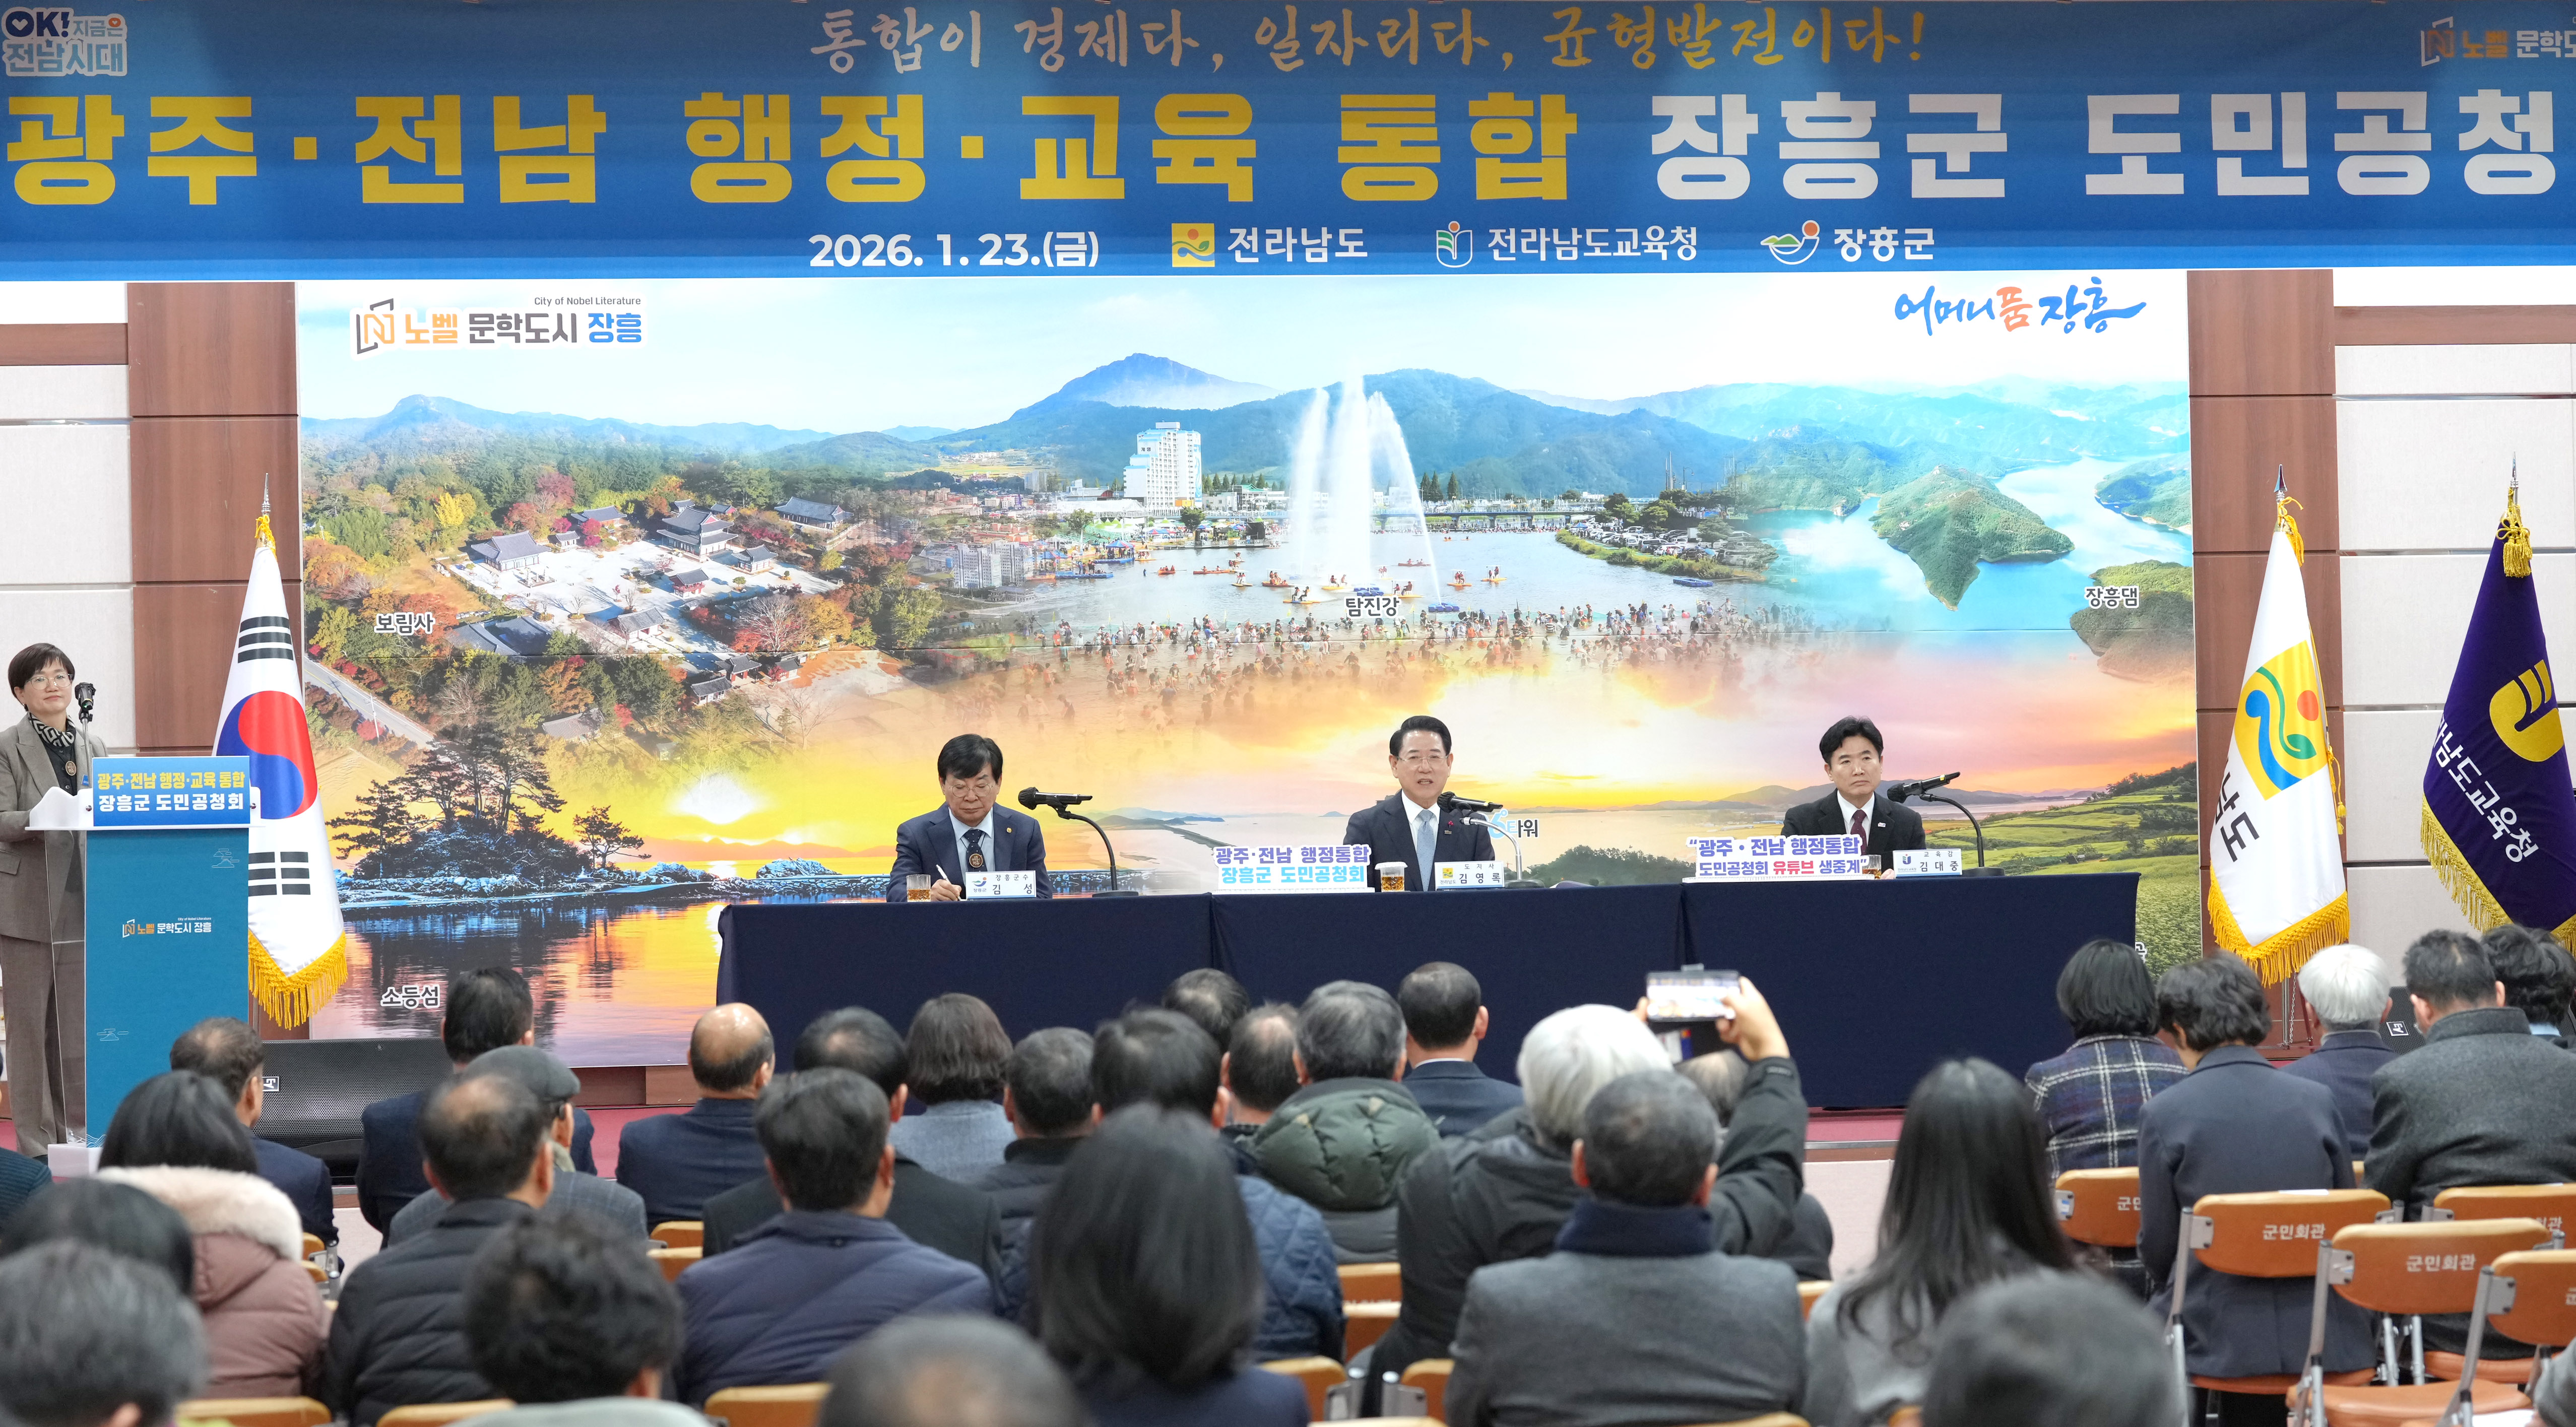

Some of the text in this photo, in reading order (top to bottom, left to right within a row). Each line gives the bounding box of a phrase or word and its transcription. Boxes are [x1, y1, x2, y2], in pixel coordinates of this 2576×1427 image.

[6, 11, 123, 38] OK! 지금은
[810, 3, 1924, 74] 통합이 경제다, 일자리다, 균형발전이다!
[7, 39, 123, 72] 전남시대
[1337, 92, 1577, 201] 통합
[1651, 91, 2007, 200] 장흥군
[2086, 89, 2556, 196] 도민공청
[809, 233, 923, 267] 2026.
[936, 233, 969, 267] 1.
[1227, 227, 1368, 262] 전라남도
[1487, 226, 1698, 262] 전라남도교육청
[1834, 227, 1935, 263] 장흥군
[534, 296, 641, 306] City of Nobel Literature
[2039, 276, 2147, 334] 장흥
[405, 313, 458, 344] 노벨
[469, 312, 577, 344] 문학도시
[588, 312, 642, 343] 장흥
[1345, 597, 1399, 617] 탐진강
[2085, 587, 2139, 608] 장흥댐
[376, 614, 433, 633] 보림사
[219, 771, 245, 788] 통합
[99, 793, 243, 812] 장흥군 도민공청회
[2216, 757, 2260, 862] 남도
[1301, 845, 1369, 863] 행정통합
[1791, 837, 1860, 855] 행정통합
[1221, 865, 1365, 884] 장흥군 도민공청회
[1700, 861, 1768, 876] 도민공청회
[1773, 861, 1814, 874] 유튜브
[157, 923, 191, 934] 문학도시
[194, 922, 212, 933] 장흥
[382, 986, 439, 1006] 소등섬
[2263, 1223, 2326, 1241] 군민회관
[2406, 1254, 2476, 1272] 군민회관
